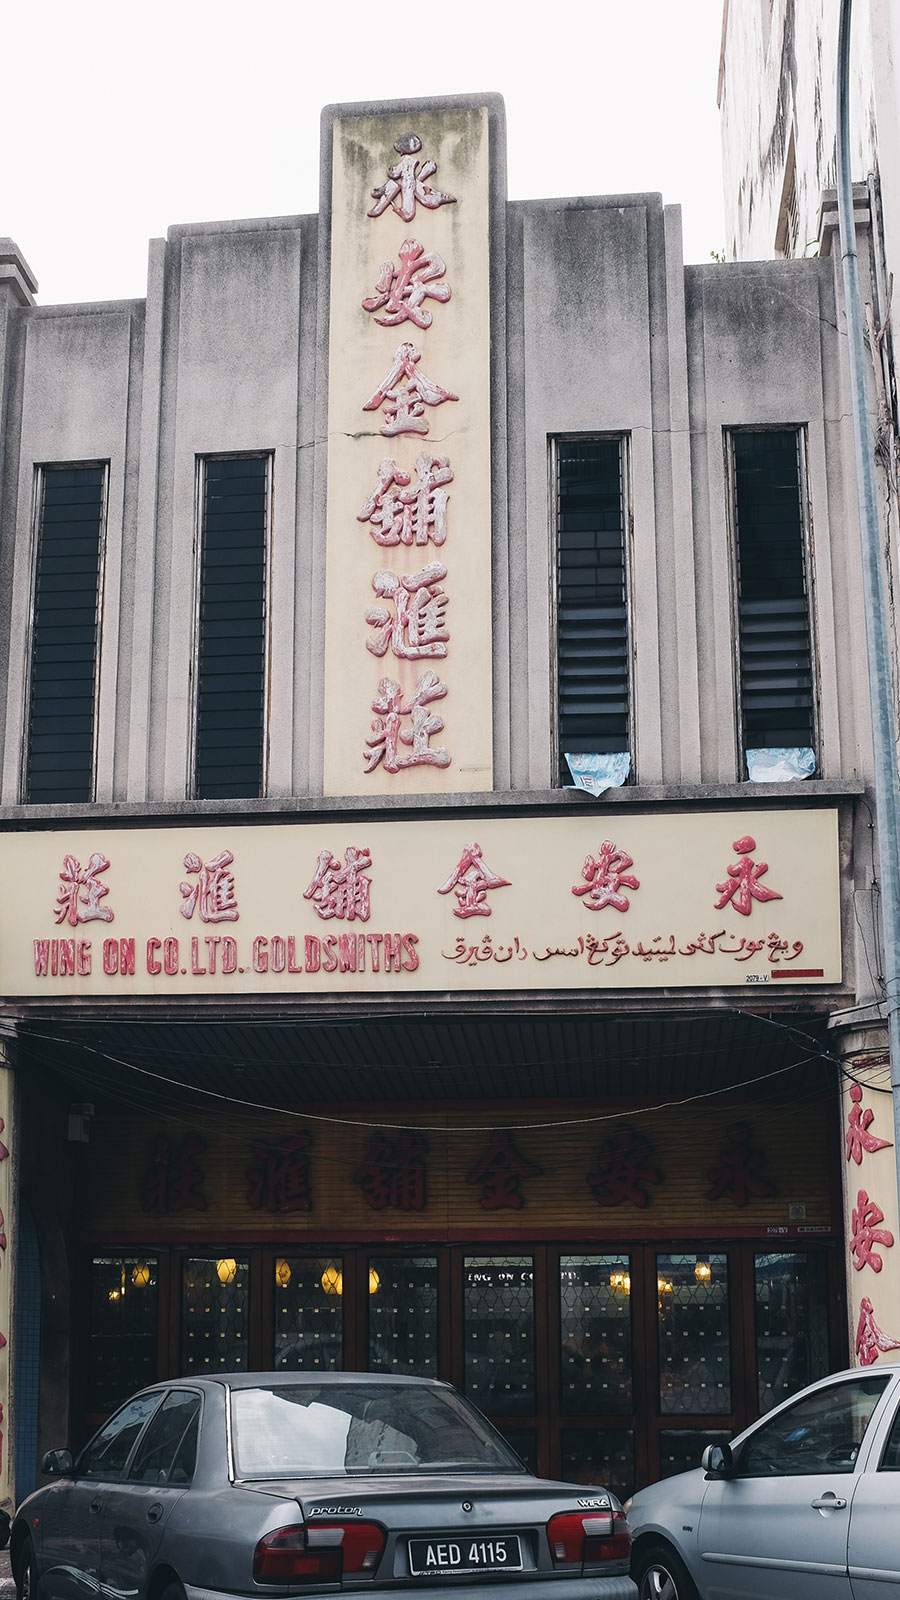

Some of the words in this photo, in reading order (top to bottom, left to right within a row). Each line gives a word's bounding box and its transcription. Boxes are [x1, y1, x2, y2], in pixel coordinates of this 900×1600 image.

[33, 938, 92, 976] WING
[103, 937, 136, 976] ON
[252, 932, 420, 974] GOLDSMITHS
[577, 1498, 609, 1508] WIRA
[426, 1544, 461, 1566] AED
[468, 1541, 507, 1564] 4115
